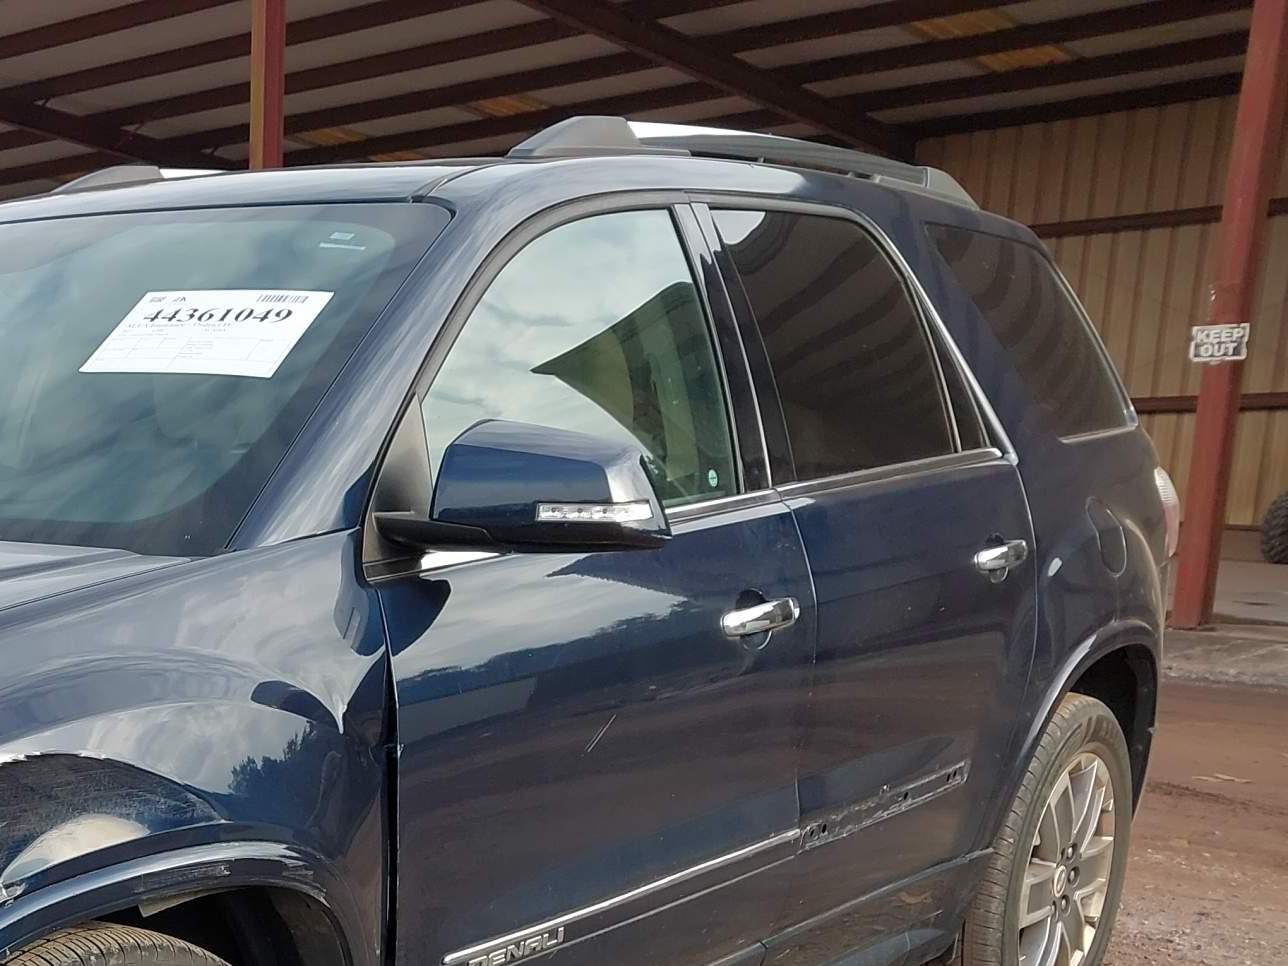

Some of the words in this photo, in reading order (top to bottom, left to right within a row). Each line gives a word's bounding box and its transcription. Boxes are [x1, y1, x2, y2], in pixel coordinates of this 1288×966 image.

[143, 307, 293, 324] 44361049
[1196, 328, 1244, 343] KEEP
[1199, 343, 1237, 357] OUT
